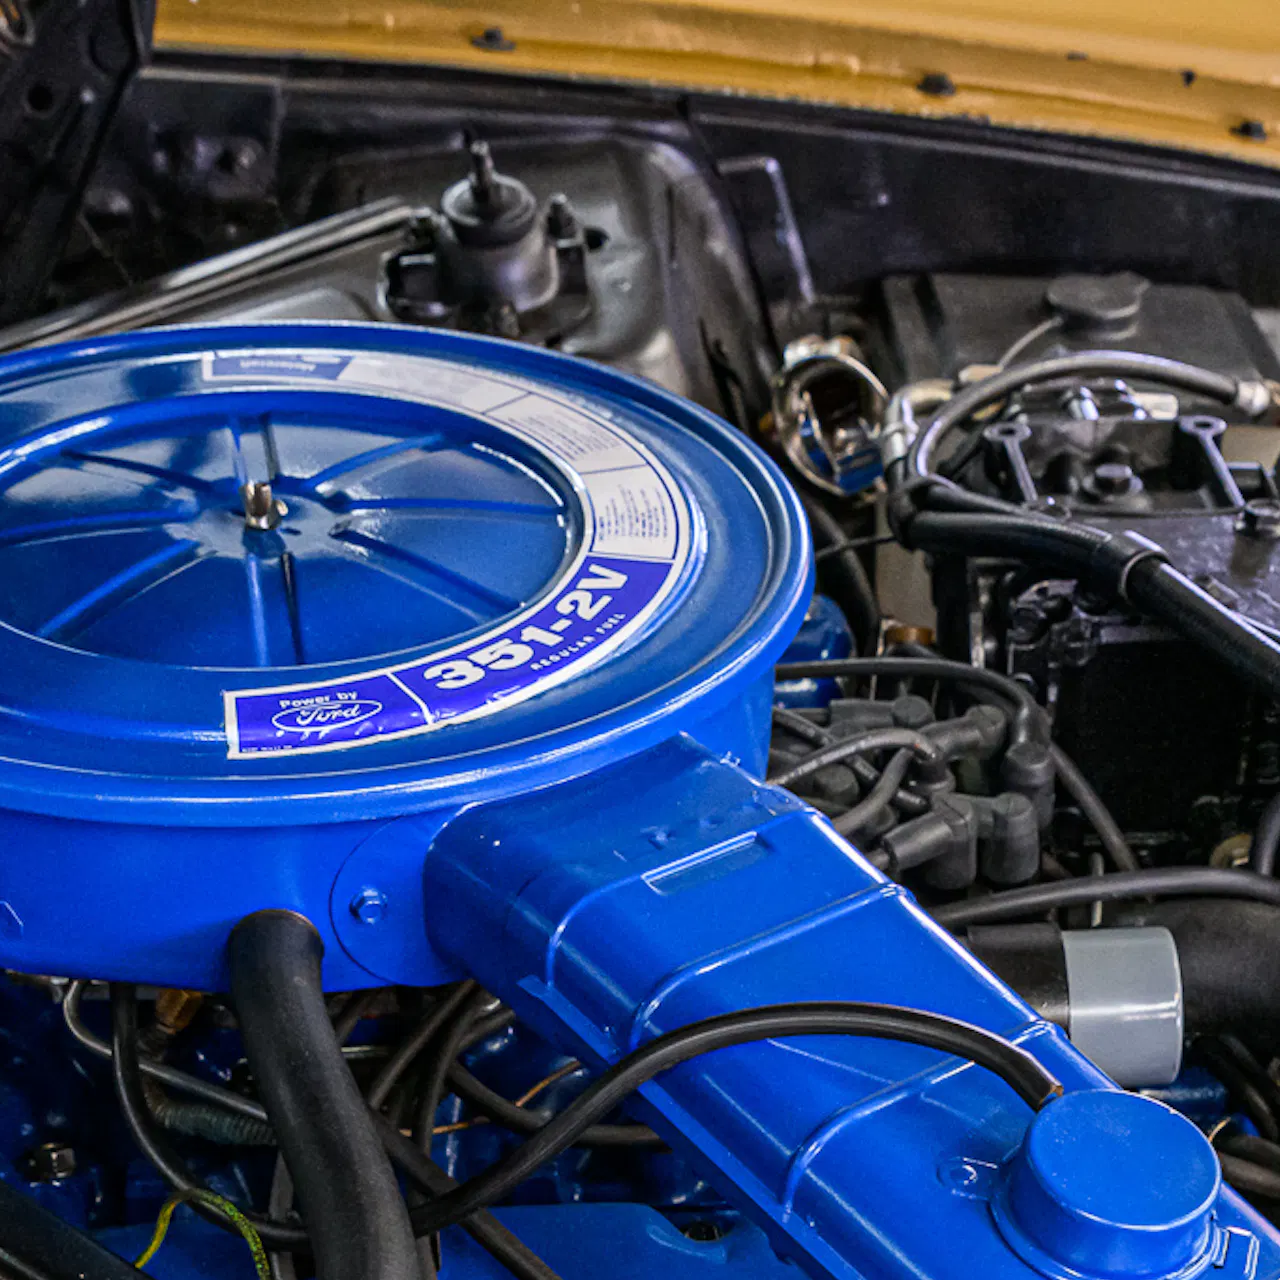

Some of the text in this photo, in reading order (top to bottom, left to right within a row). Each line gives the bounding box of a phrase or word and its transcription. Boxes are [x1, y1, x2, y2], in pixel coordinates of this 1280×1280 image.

[423, 563, 629, 690] 351-2V
[529, 612, 627, 671] REGULAR FUEL
[278, 691, 359, 709] Power by
[295, 702, 363, 727] Ford
